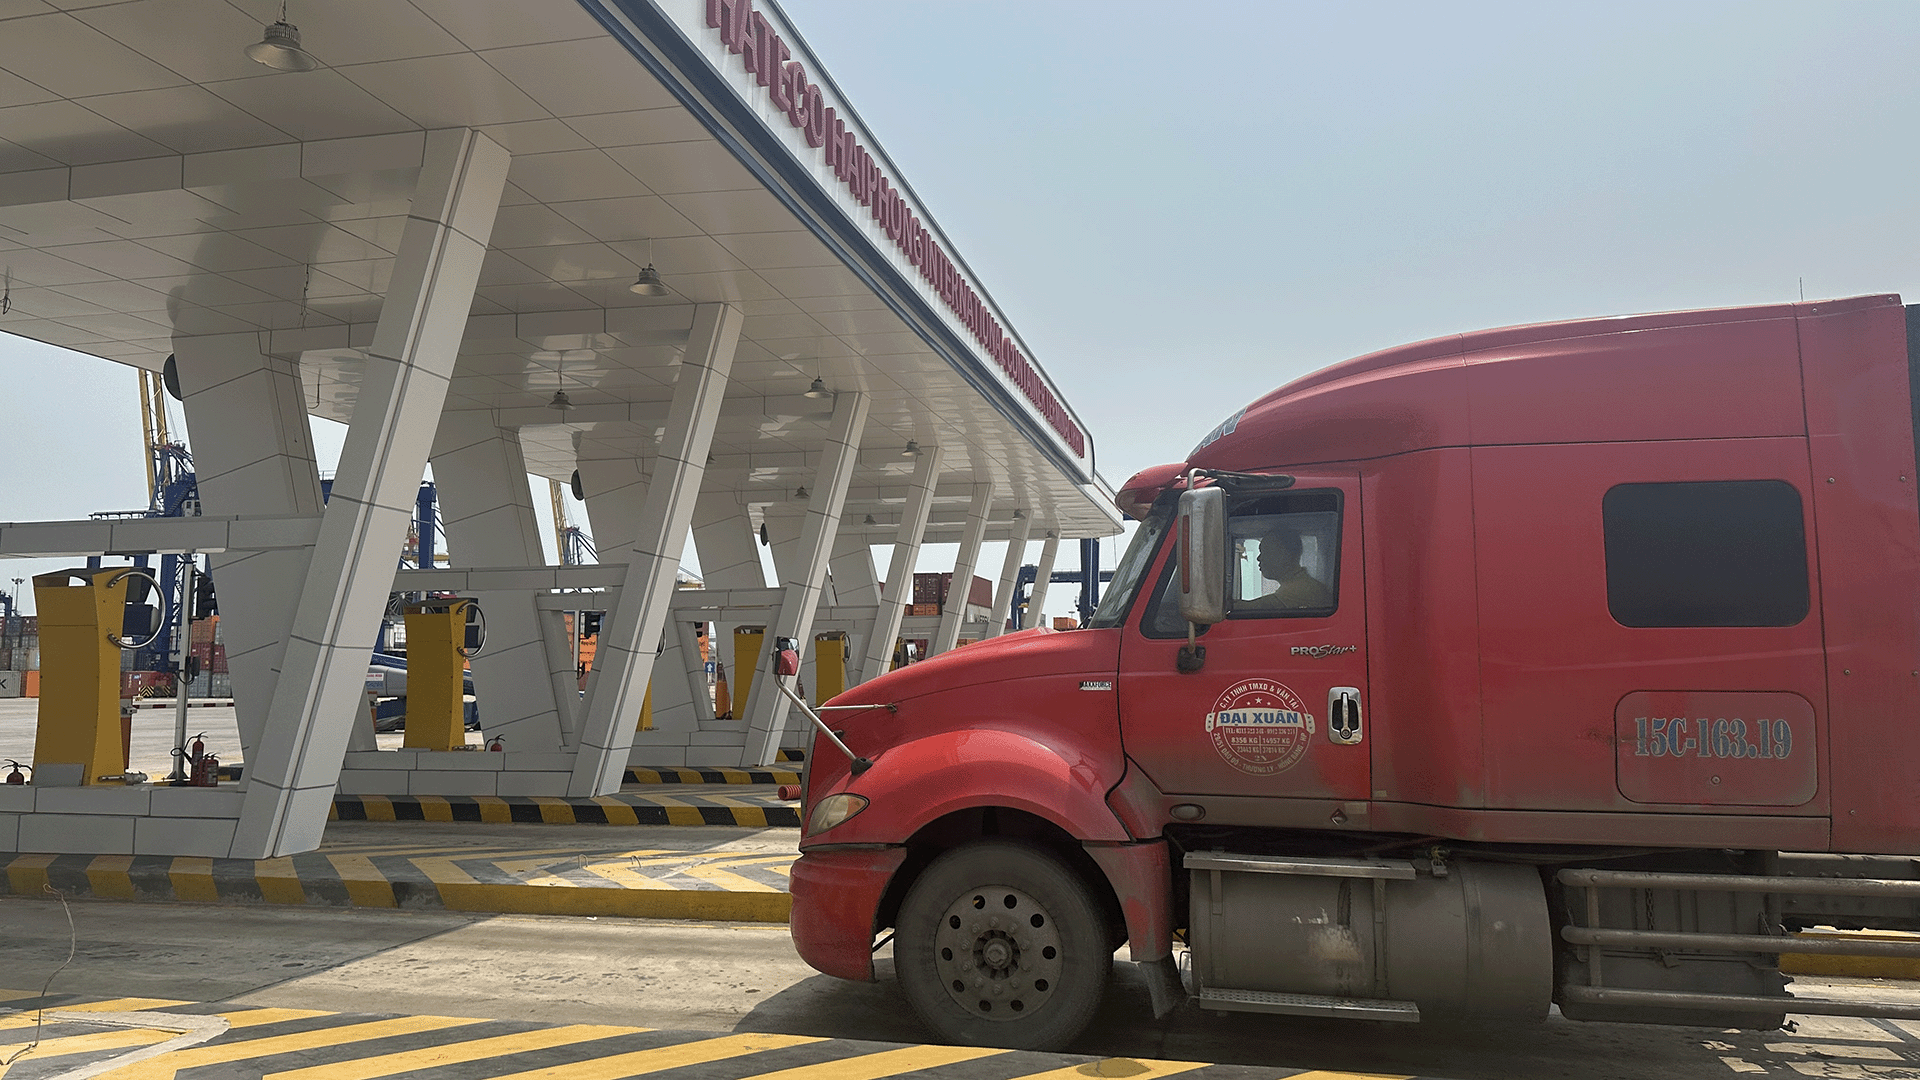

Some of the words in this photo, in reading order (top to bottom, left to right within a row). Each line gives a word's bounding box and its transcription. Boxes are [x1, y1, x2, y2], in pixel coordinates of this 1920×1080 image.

[1220, 712, 1247, 726] ĐẠI
[1252, 710, 1298, 724] XUÂN
[1635, 717, 1793, 759] 15C-163.19
